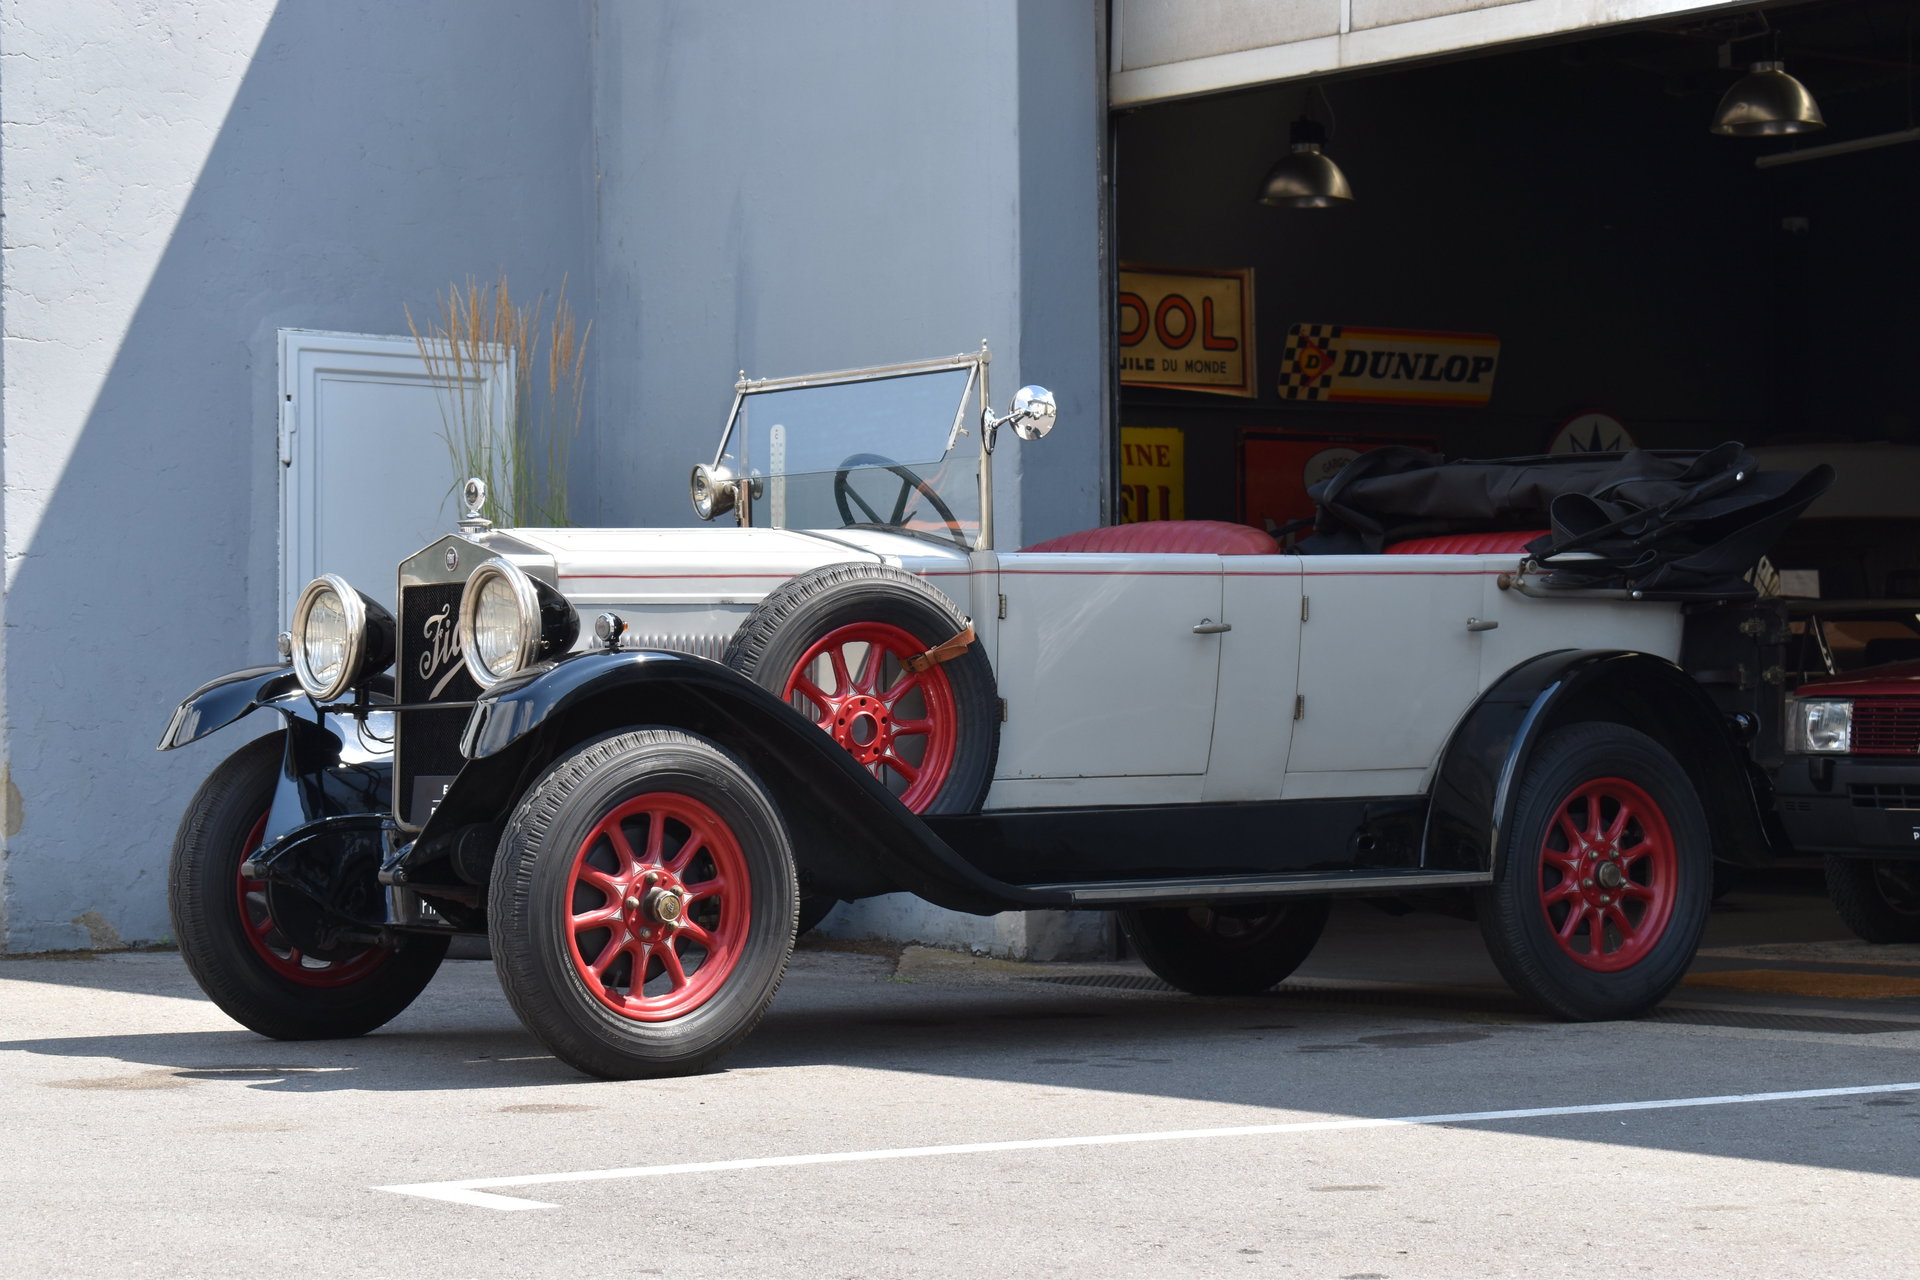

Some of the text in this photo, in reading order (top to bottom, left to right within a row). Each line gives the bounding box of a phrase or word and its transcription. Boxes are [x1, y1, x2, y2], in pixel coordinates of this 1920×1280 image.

[1162, 359, 1178, 372] DU
[1184, 360, 1227, 374] MONDE
[1305, 354, 1320, 369] D
[1338, 350, 1494, 383] DUNLOP
[1122, 443, 1171, 468] INE
